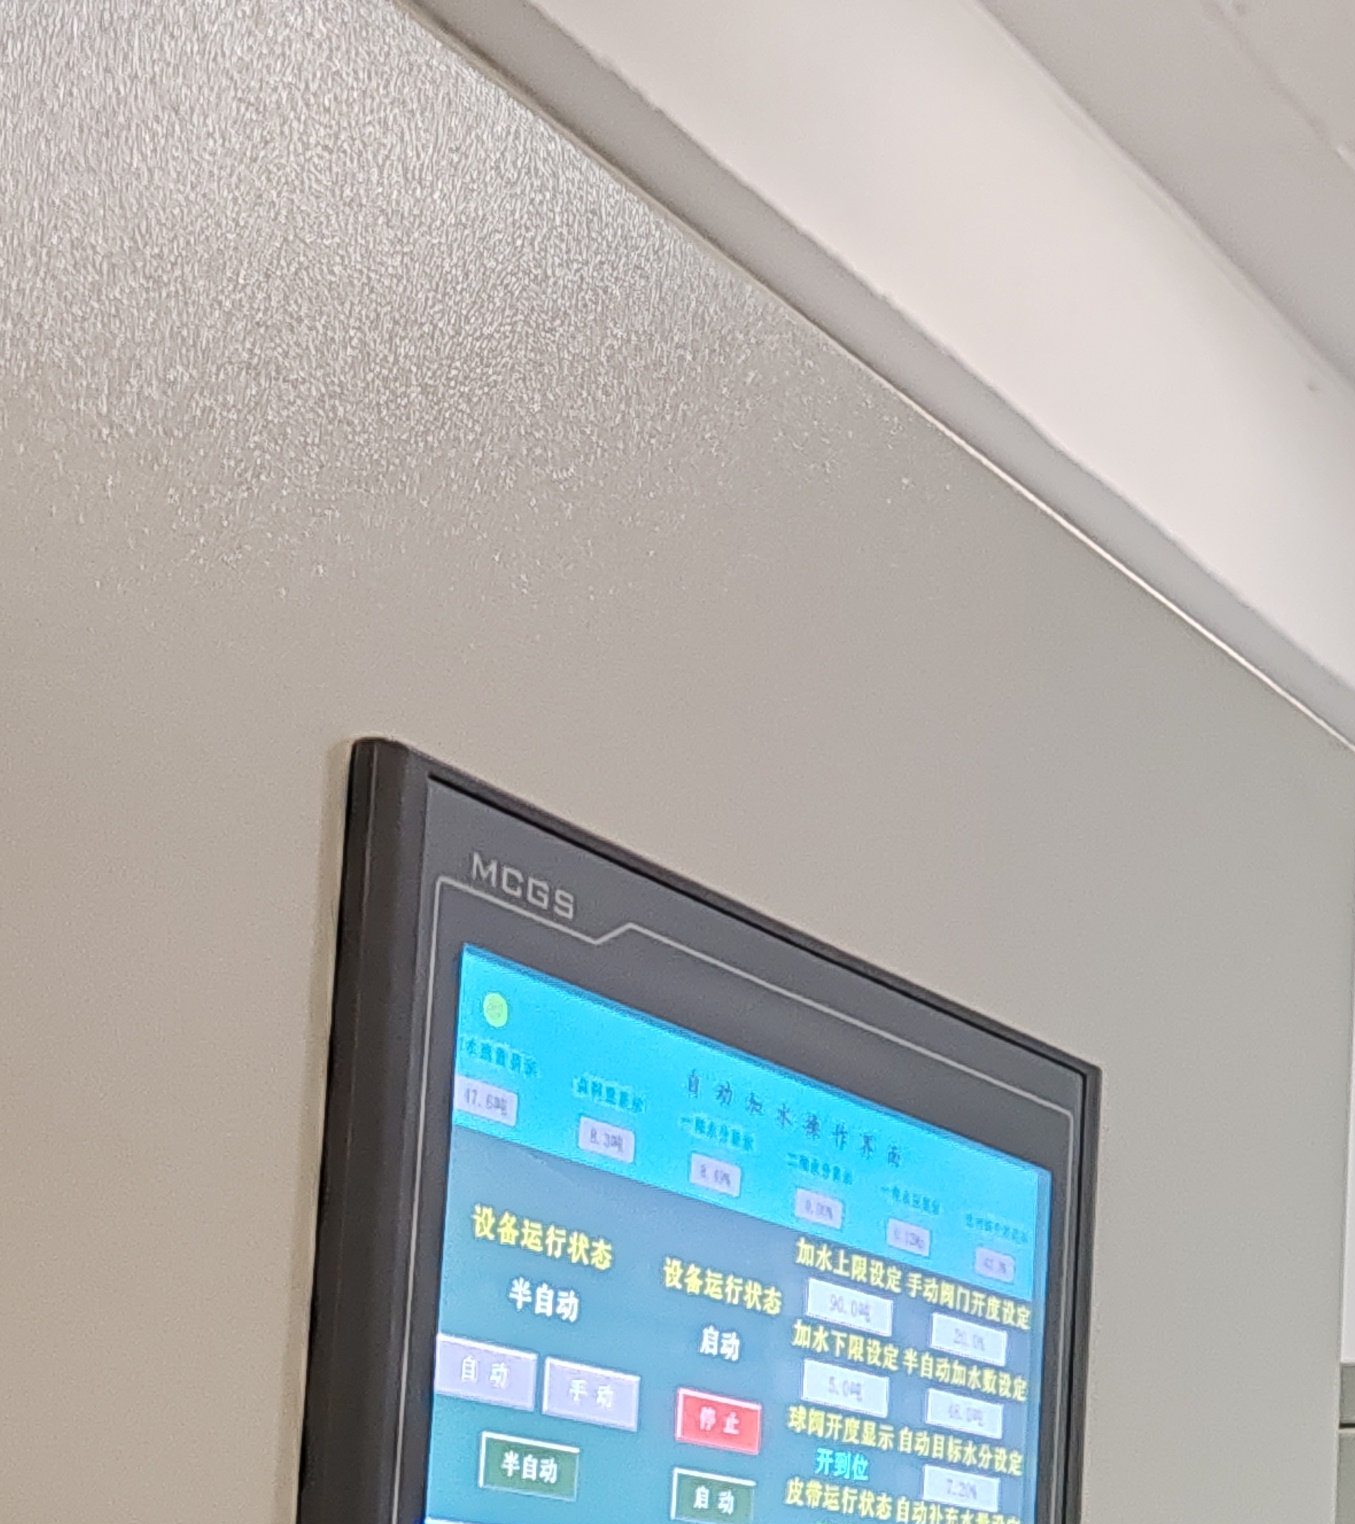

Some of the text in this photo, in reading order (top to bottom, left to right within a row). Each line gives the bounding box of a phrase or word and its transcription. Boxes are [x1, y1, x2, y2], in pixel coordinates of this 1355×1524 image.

[472, 851, 575, 920] MCGS
[687, 1068, 902, 1168] 自动加水操作界面
[472, 1203, 614, 1271] 设备运行状态
[663, 1257, 783, 1316] 设备运行状态
[796, 1238, 902, 1293] 加水上限设定
[509, 1277, 581, 1323] 半自动
[906, 1272, 1031, 1331] 手动阀门开度设定
[700, 1325, 741, 1362] 启动
[792, 1319, 898, 1371] 加水下限设定
[461, 1355, 510, 1388] 自动
[569, 1379, 614, 1409] 手动
[903, 1348, 1028, 1402] 半自动加水数设定
[700, 1406, 740, 1435] 停止
[787, 1405, 895, 1450] 球阀开度显示
[501, 1450, 559, 1484] 半自动
[814, 1448, 869, 1481] 开到位
[898, 1426, 1023, 1476] 自动目标水分设定
[693, 1486, 734, 1515] 启动
[785, 1477, 893, 1520] 皮带运行状态
